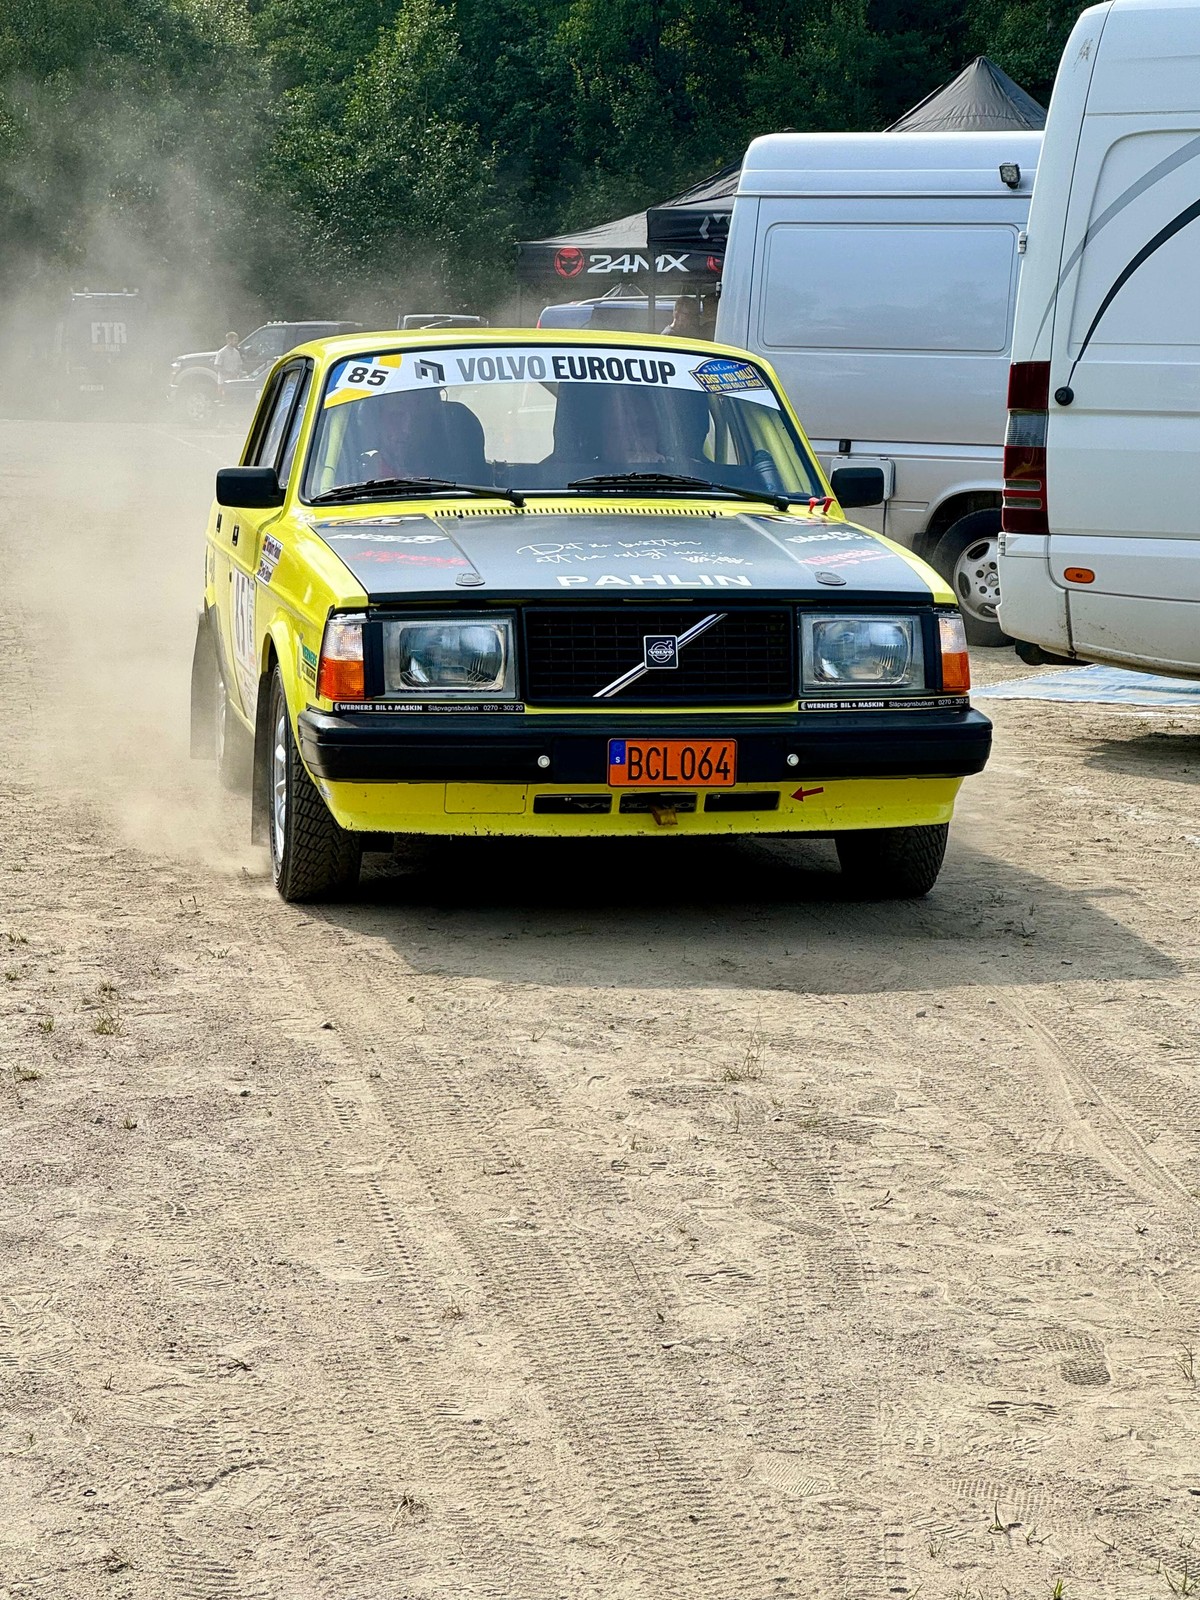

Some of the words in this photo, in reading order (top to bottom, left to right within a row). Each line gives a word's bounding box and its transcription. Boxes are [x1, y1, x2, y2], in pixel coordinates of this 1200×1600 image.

[91, 322, 127, 344] FTR
[347, 366, 389, 386] 85
[456, 355, 547, 382] VOLVO
[551, 355, 676, 384] EUROCUP
[556, 574, 753, 587] PAHLIN
[340, 703, 373, 711] WERNERS
[375, 703, 387, 711] BIL
[394, 703, 423, 711] MASKIN
[938, 698, 951, 706] 0270
[615, 756, 621, 764] S
